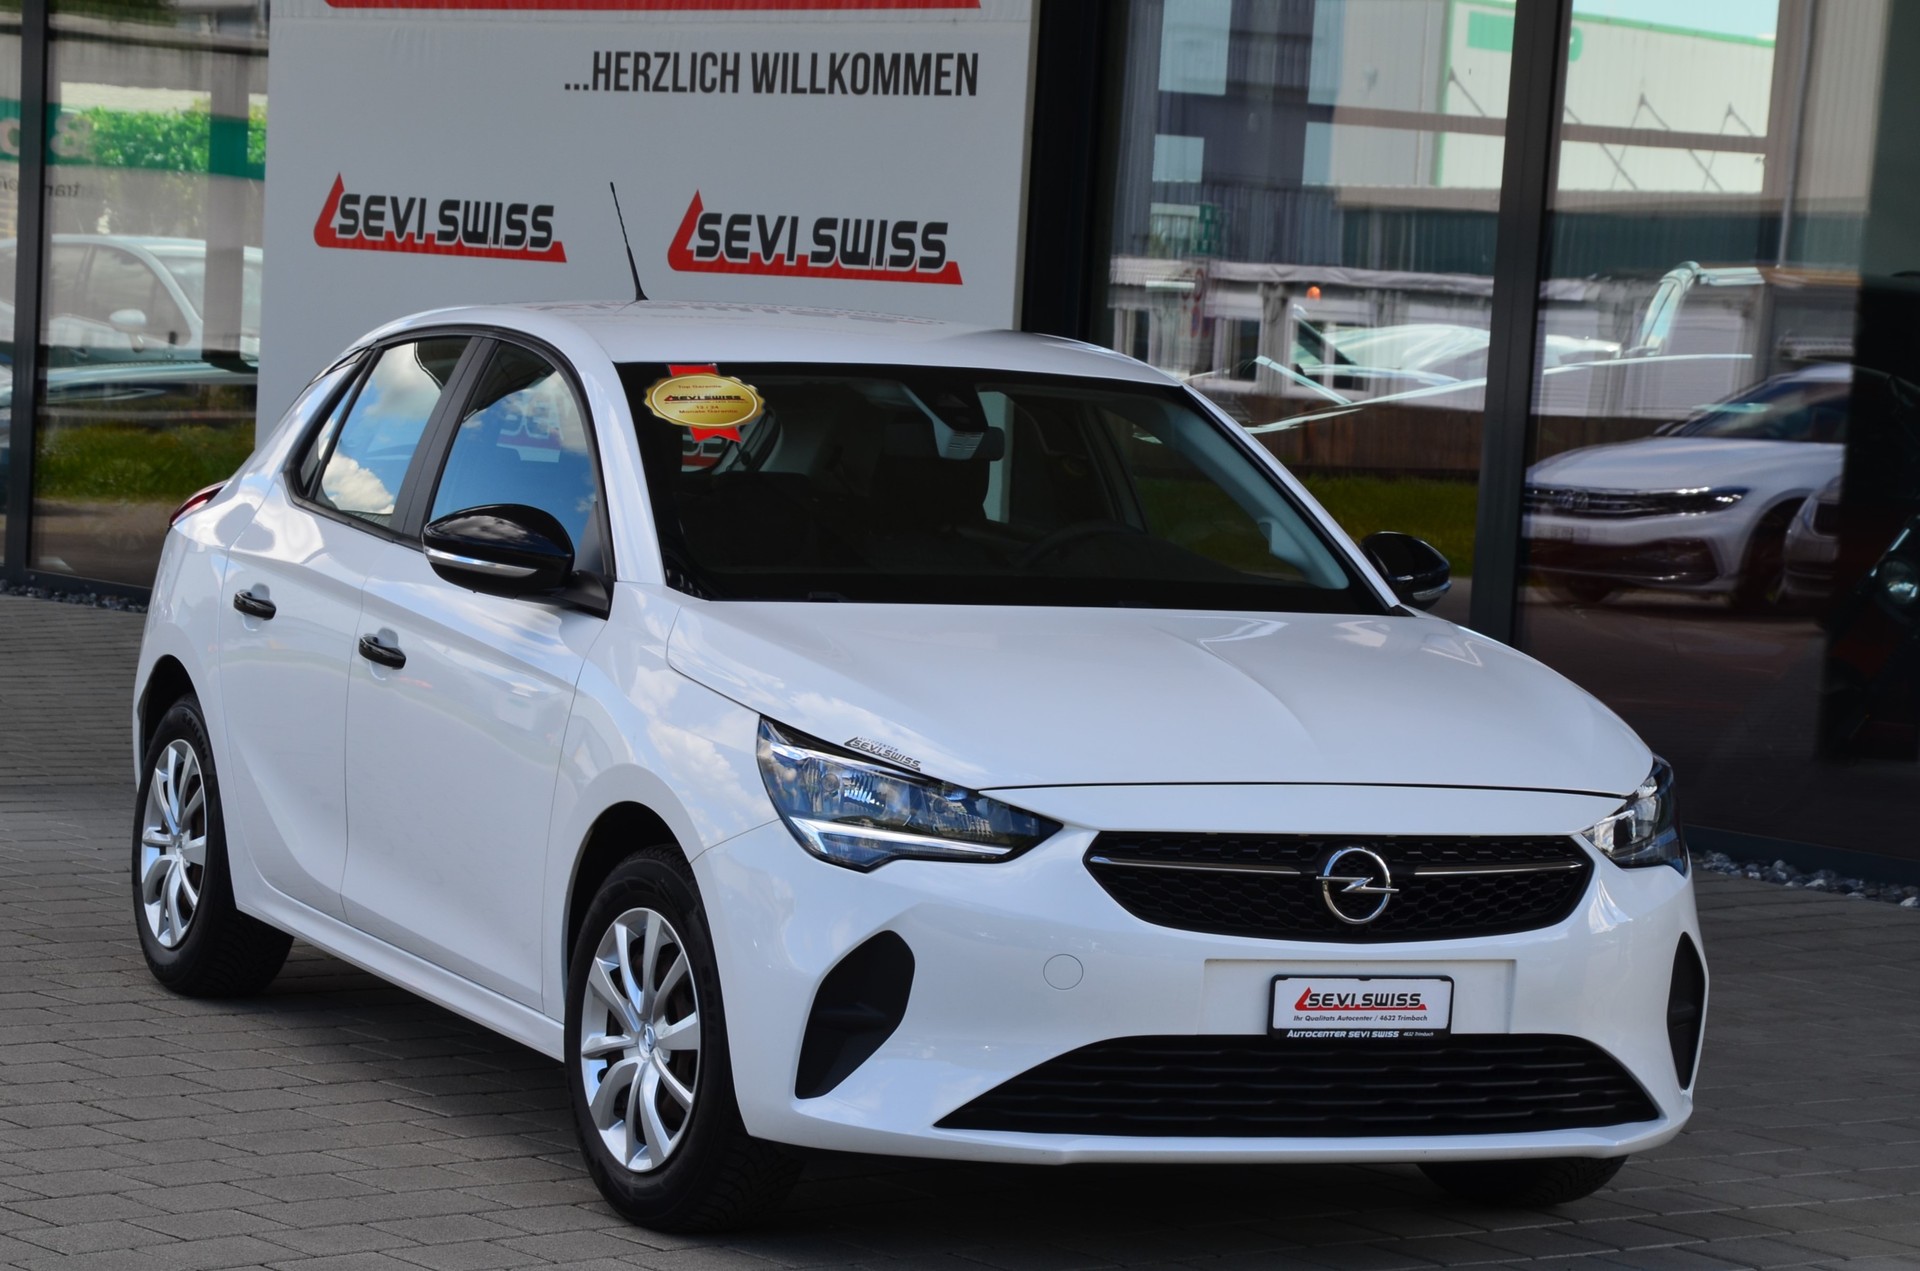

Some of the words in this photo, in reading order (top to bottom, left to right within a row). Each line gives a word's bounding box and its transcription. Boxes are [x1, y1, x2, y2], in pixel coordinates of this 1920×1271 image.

[564, 51, 740, 94] ...HERZLICH
[751, 52, 979, 96] WILLKOMMEN
[337, 193, 427, 241] SEVI
[436, 199, 554, 248] SWISS
[695, 212, 799, 262] SEVI
[809, 217, 949, 270] SWISS
[853, 740, 883, 754] SEVI
[883, 750, 921, 767] SWISS
[1308, 993, 1356, 1007] SEVI
[1361, 993, 1422, 1007] SWISS
